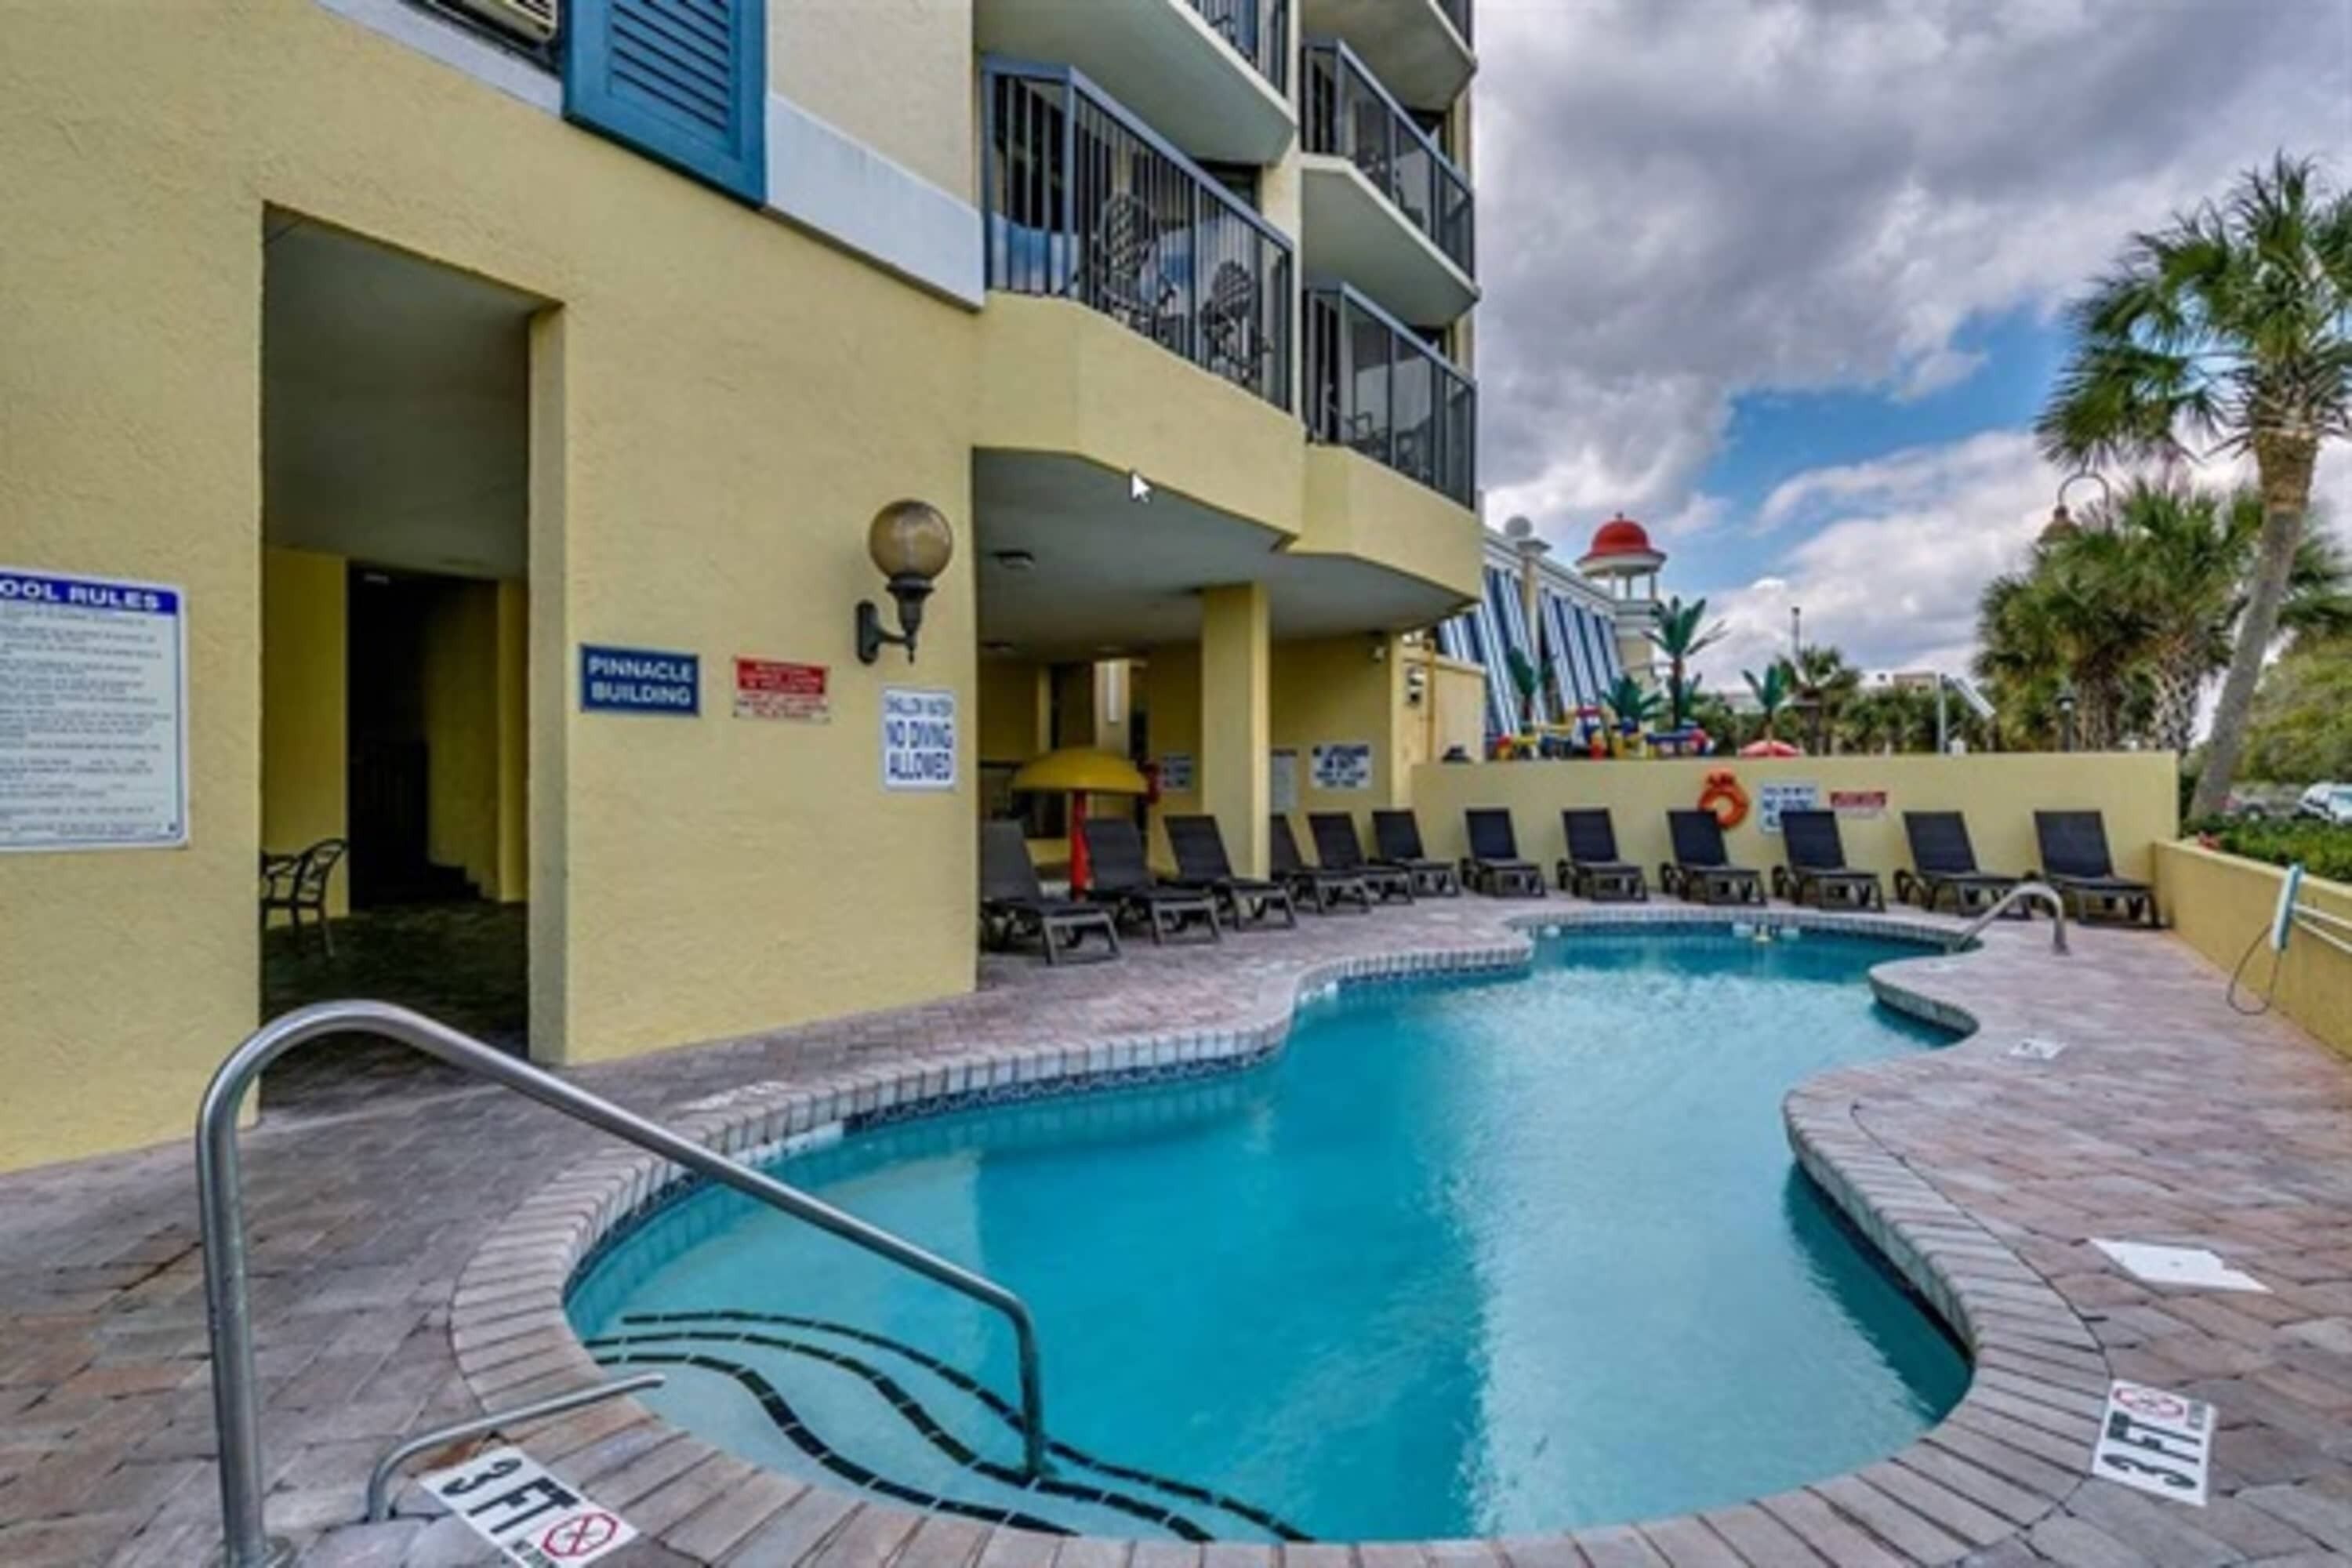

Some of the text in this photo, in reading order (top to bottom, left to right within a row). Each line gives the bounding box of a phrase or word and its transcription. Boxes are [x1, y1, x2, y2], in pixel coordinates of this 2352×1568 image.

[69, 585, 161, 610] RULES
[589, 655, 693, 682] PINNACLE
[591, 681, 691, 706] BUILDING
[886, 720, 951, 750] NO DIVING
[889, 752, 950, 780] ALLOWED
[2101, 1410, 2201, 1490] 3 FT
[440, 1457, 579, 1534] 3 FT
